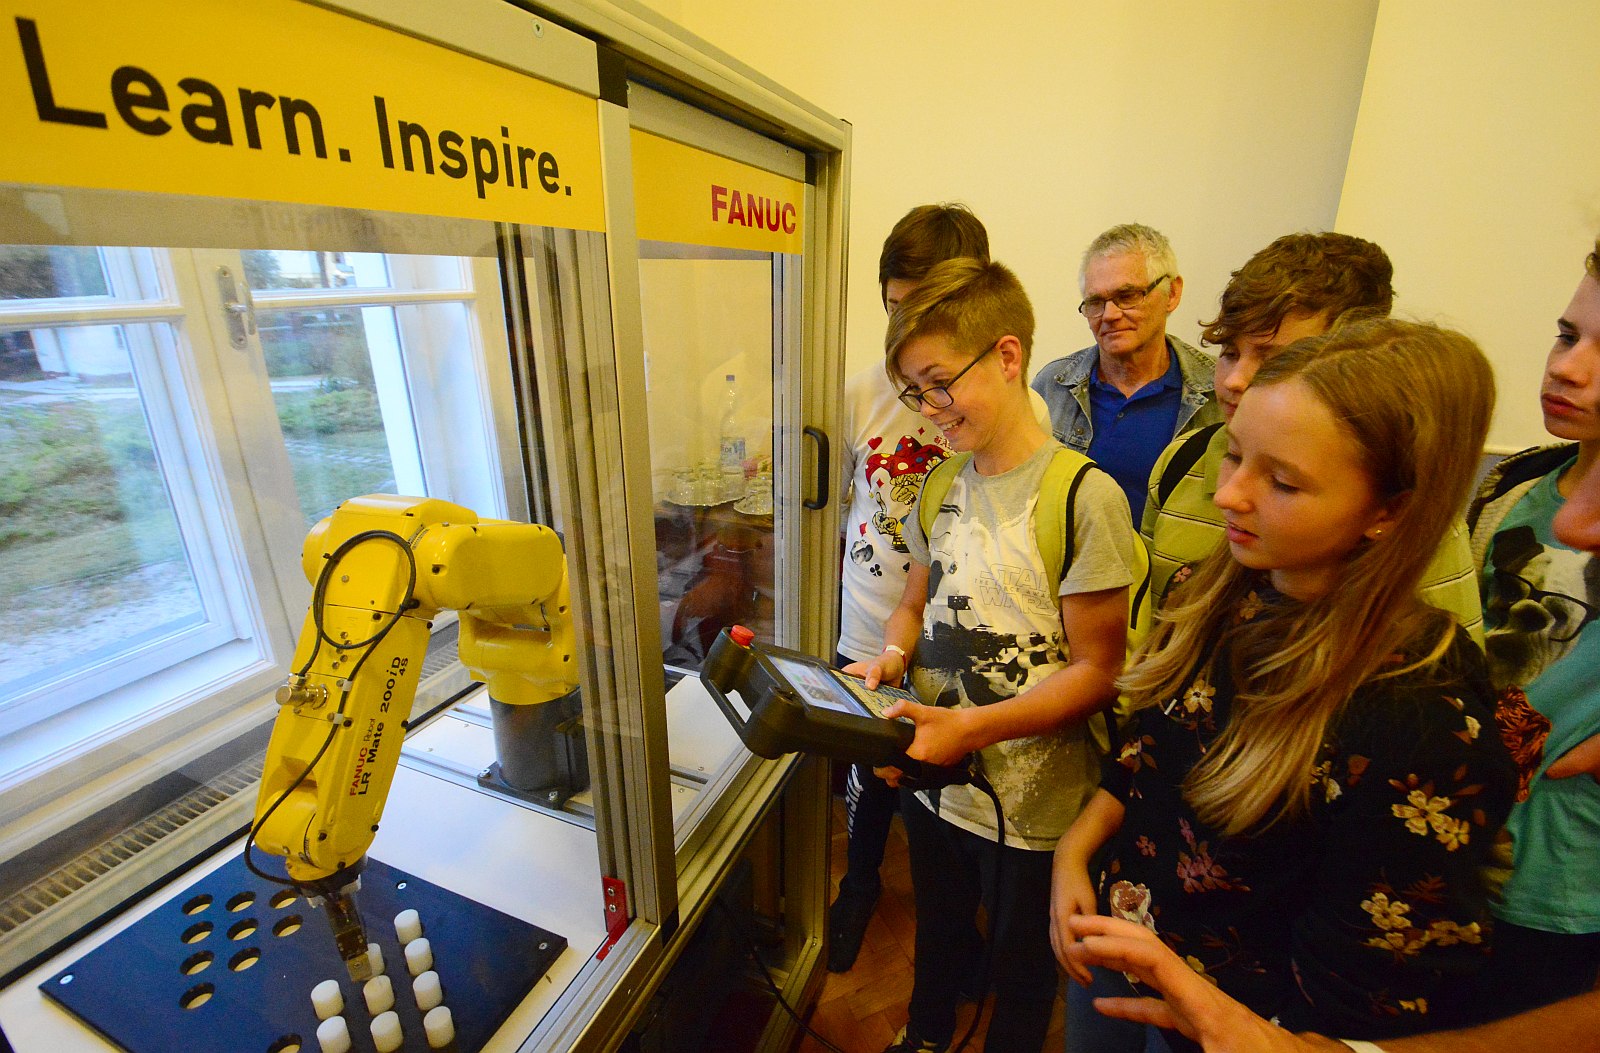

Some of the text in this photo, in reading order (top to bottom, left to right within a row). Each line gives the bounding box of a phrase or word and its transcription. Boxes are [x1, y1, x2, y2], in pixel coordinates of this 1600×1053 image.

[15, 16, 572, 199] Learn. Inspire.
[711, 184, 796, 234] FANUC
[399, 657, 409, 676] 4S
[349, 718, 376, 796] FANUC Robot
[358, 656, 401, 795] LR Mate 200iD
